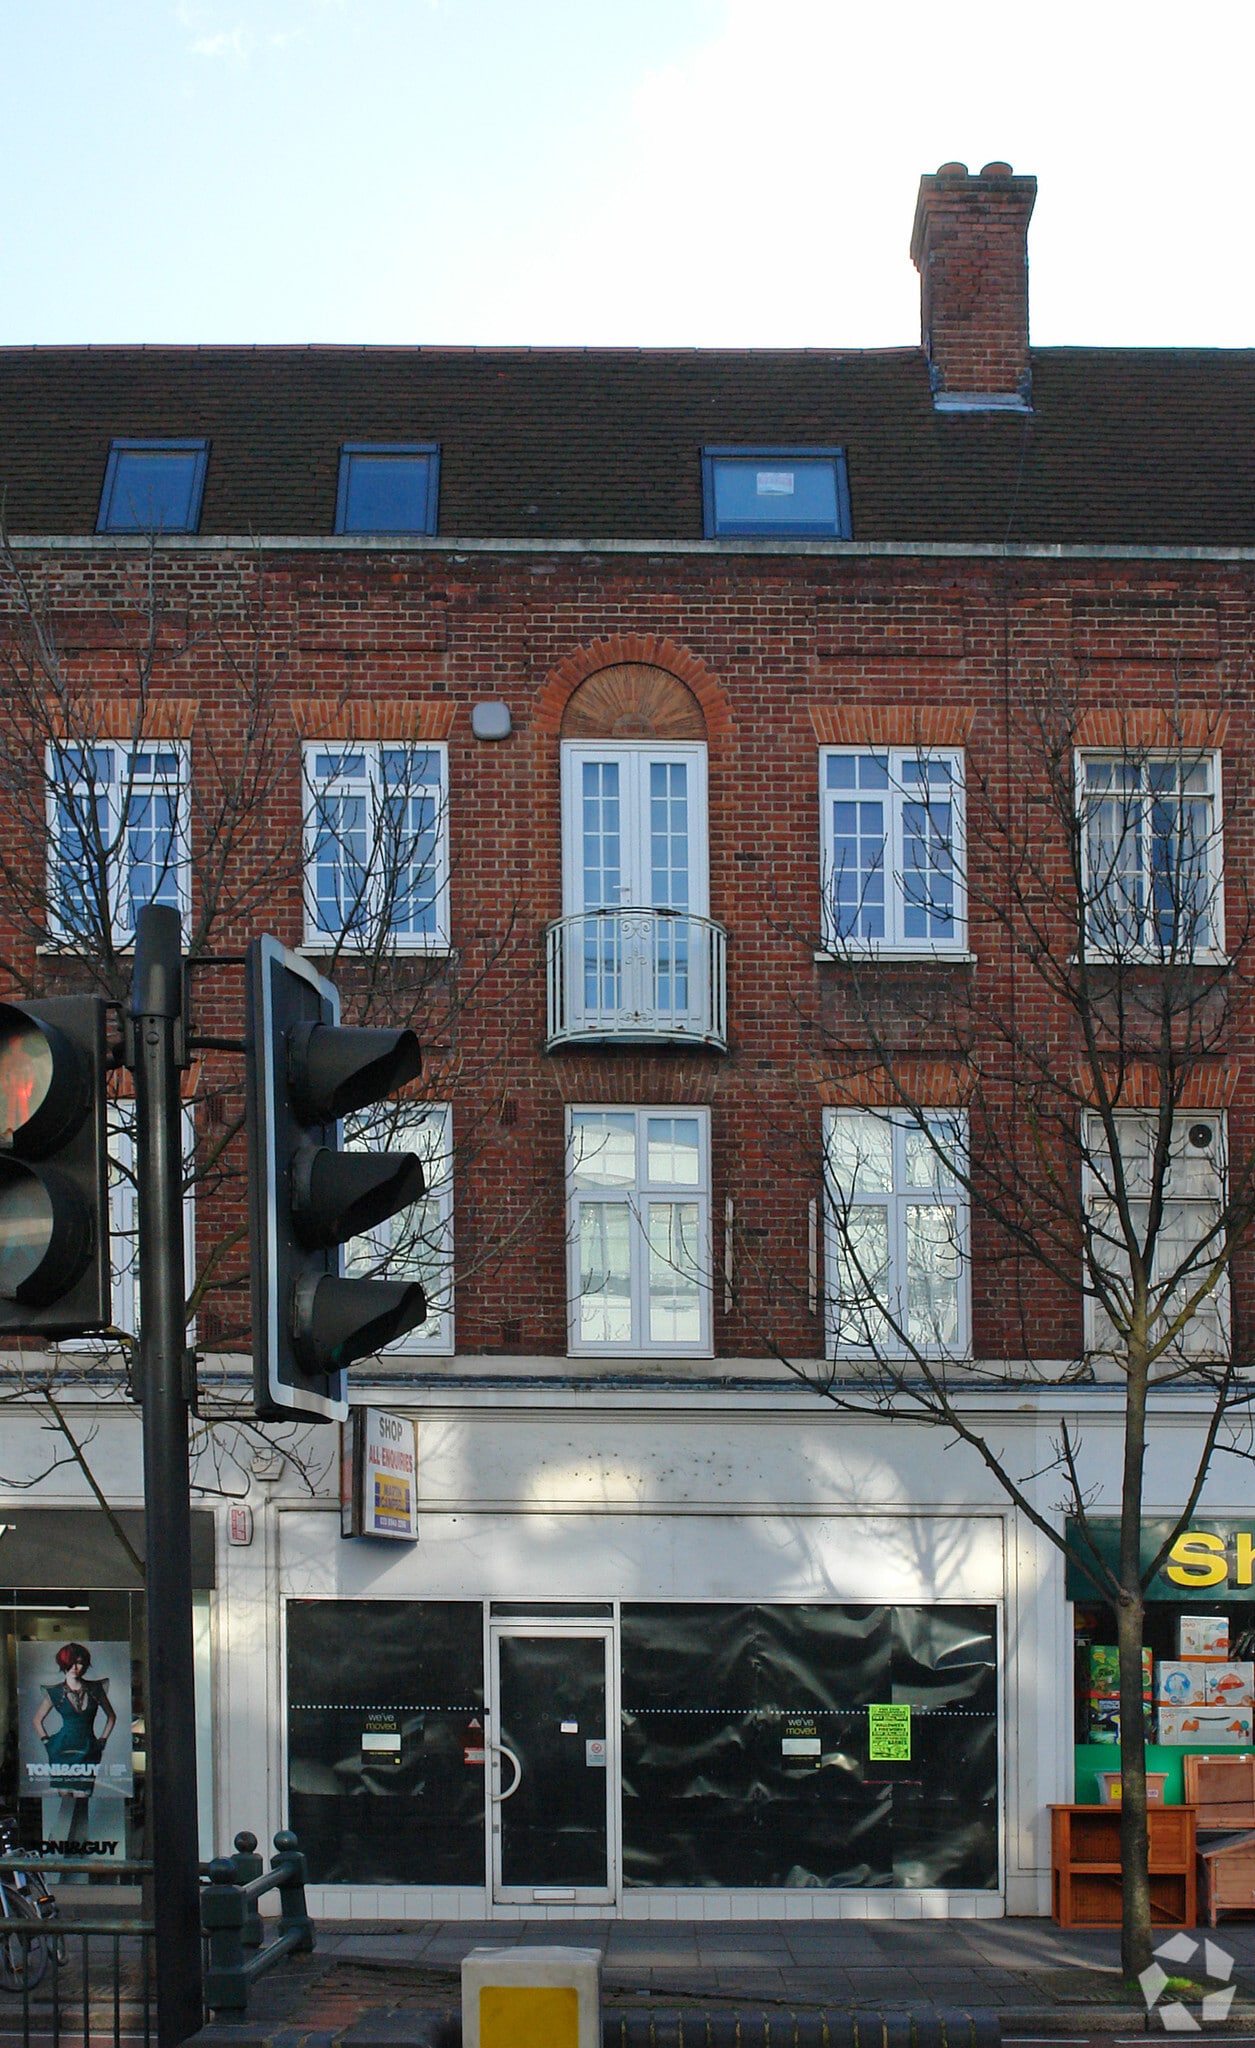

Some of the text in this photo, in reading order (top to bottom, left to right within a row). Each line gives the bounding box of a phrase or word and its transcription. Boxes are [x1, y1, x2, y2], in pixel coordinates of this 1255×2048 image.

[379, 1416, 403, 1442] SHOP
[369, 1444, 413, 1473] ALL ENQUIRIES
[368, 1712, 394, 1722] we've
[787, 1717, 814, 1726] we've
[365, 1721, 397, 1731] moved
[785, 1726, 817, 1736] moved
[26, 1763, 102, 1777] TONI&GUY
